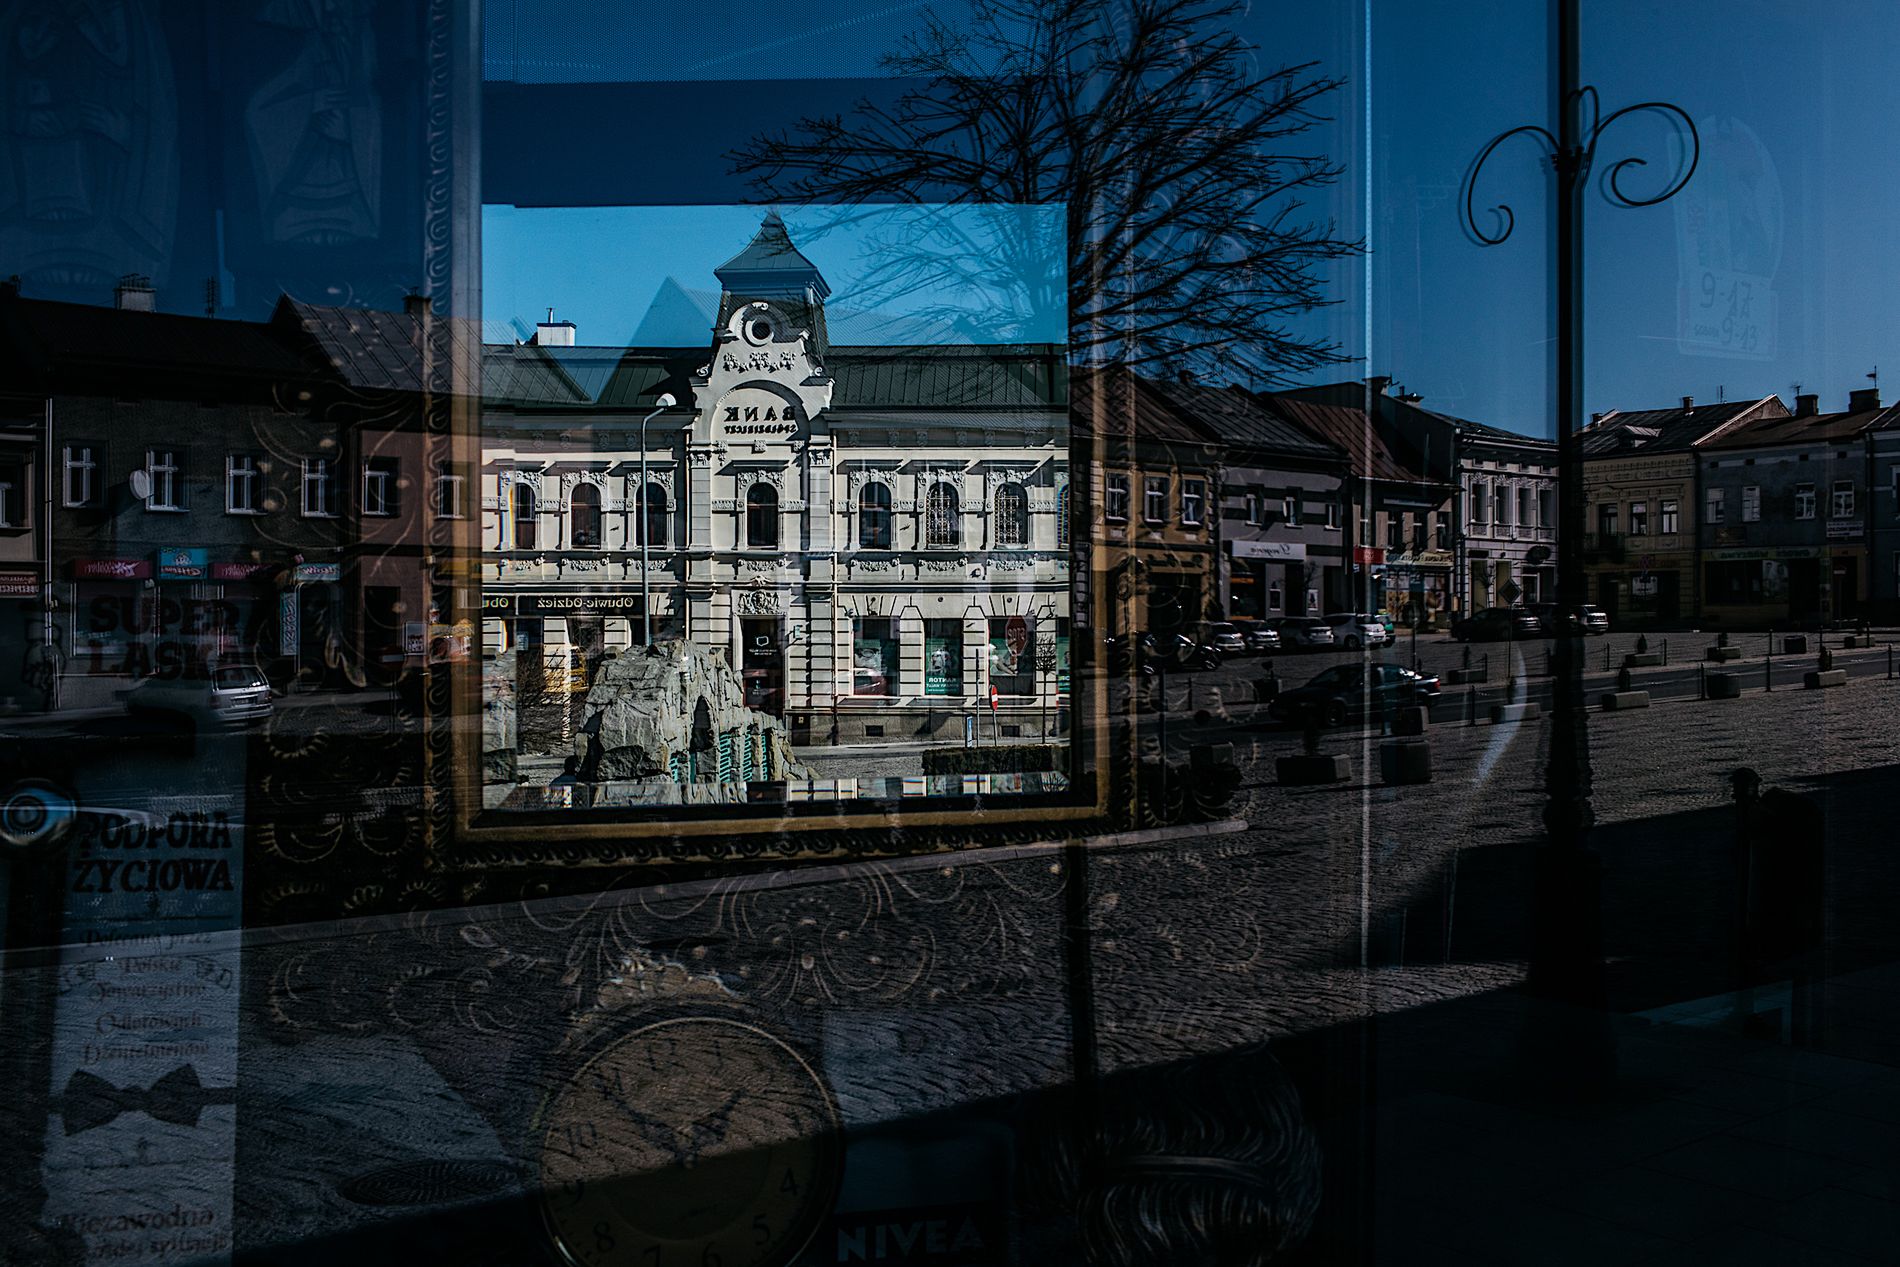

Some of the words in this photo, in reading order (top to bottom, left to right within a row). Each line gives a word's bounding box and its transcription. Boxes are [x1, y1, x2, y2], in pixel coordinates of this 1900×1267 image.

[88, 595, 240, 636] SUPER
[77, 812, 231, 849] PODPORA
[779, 1167, 799, 1197] 4
[593, 1220, 616, 1253] 8
[752, 1213, 771, 1246] 5
[835, 1215, 986, 1264] NIVEA
